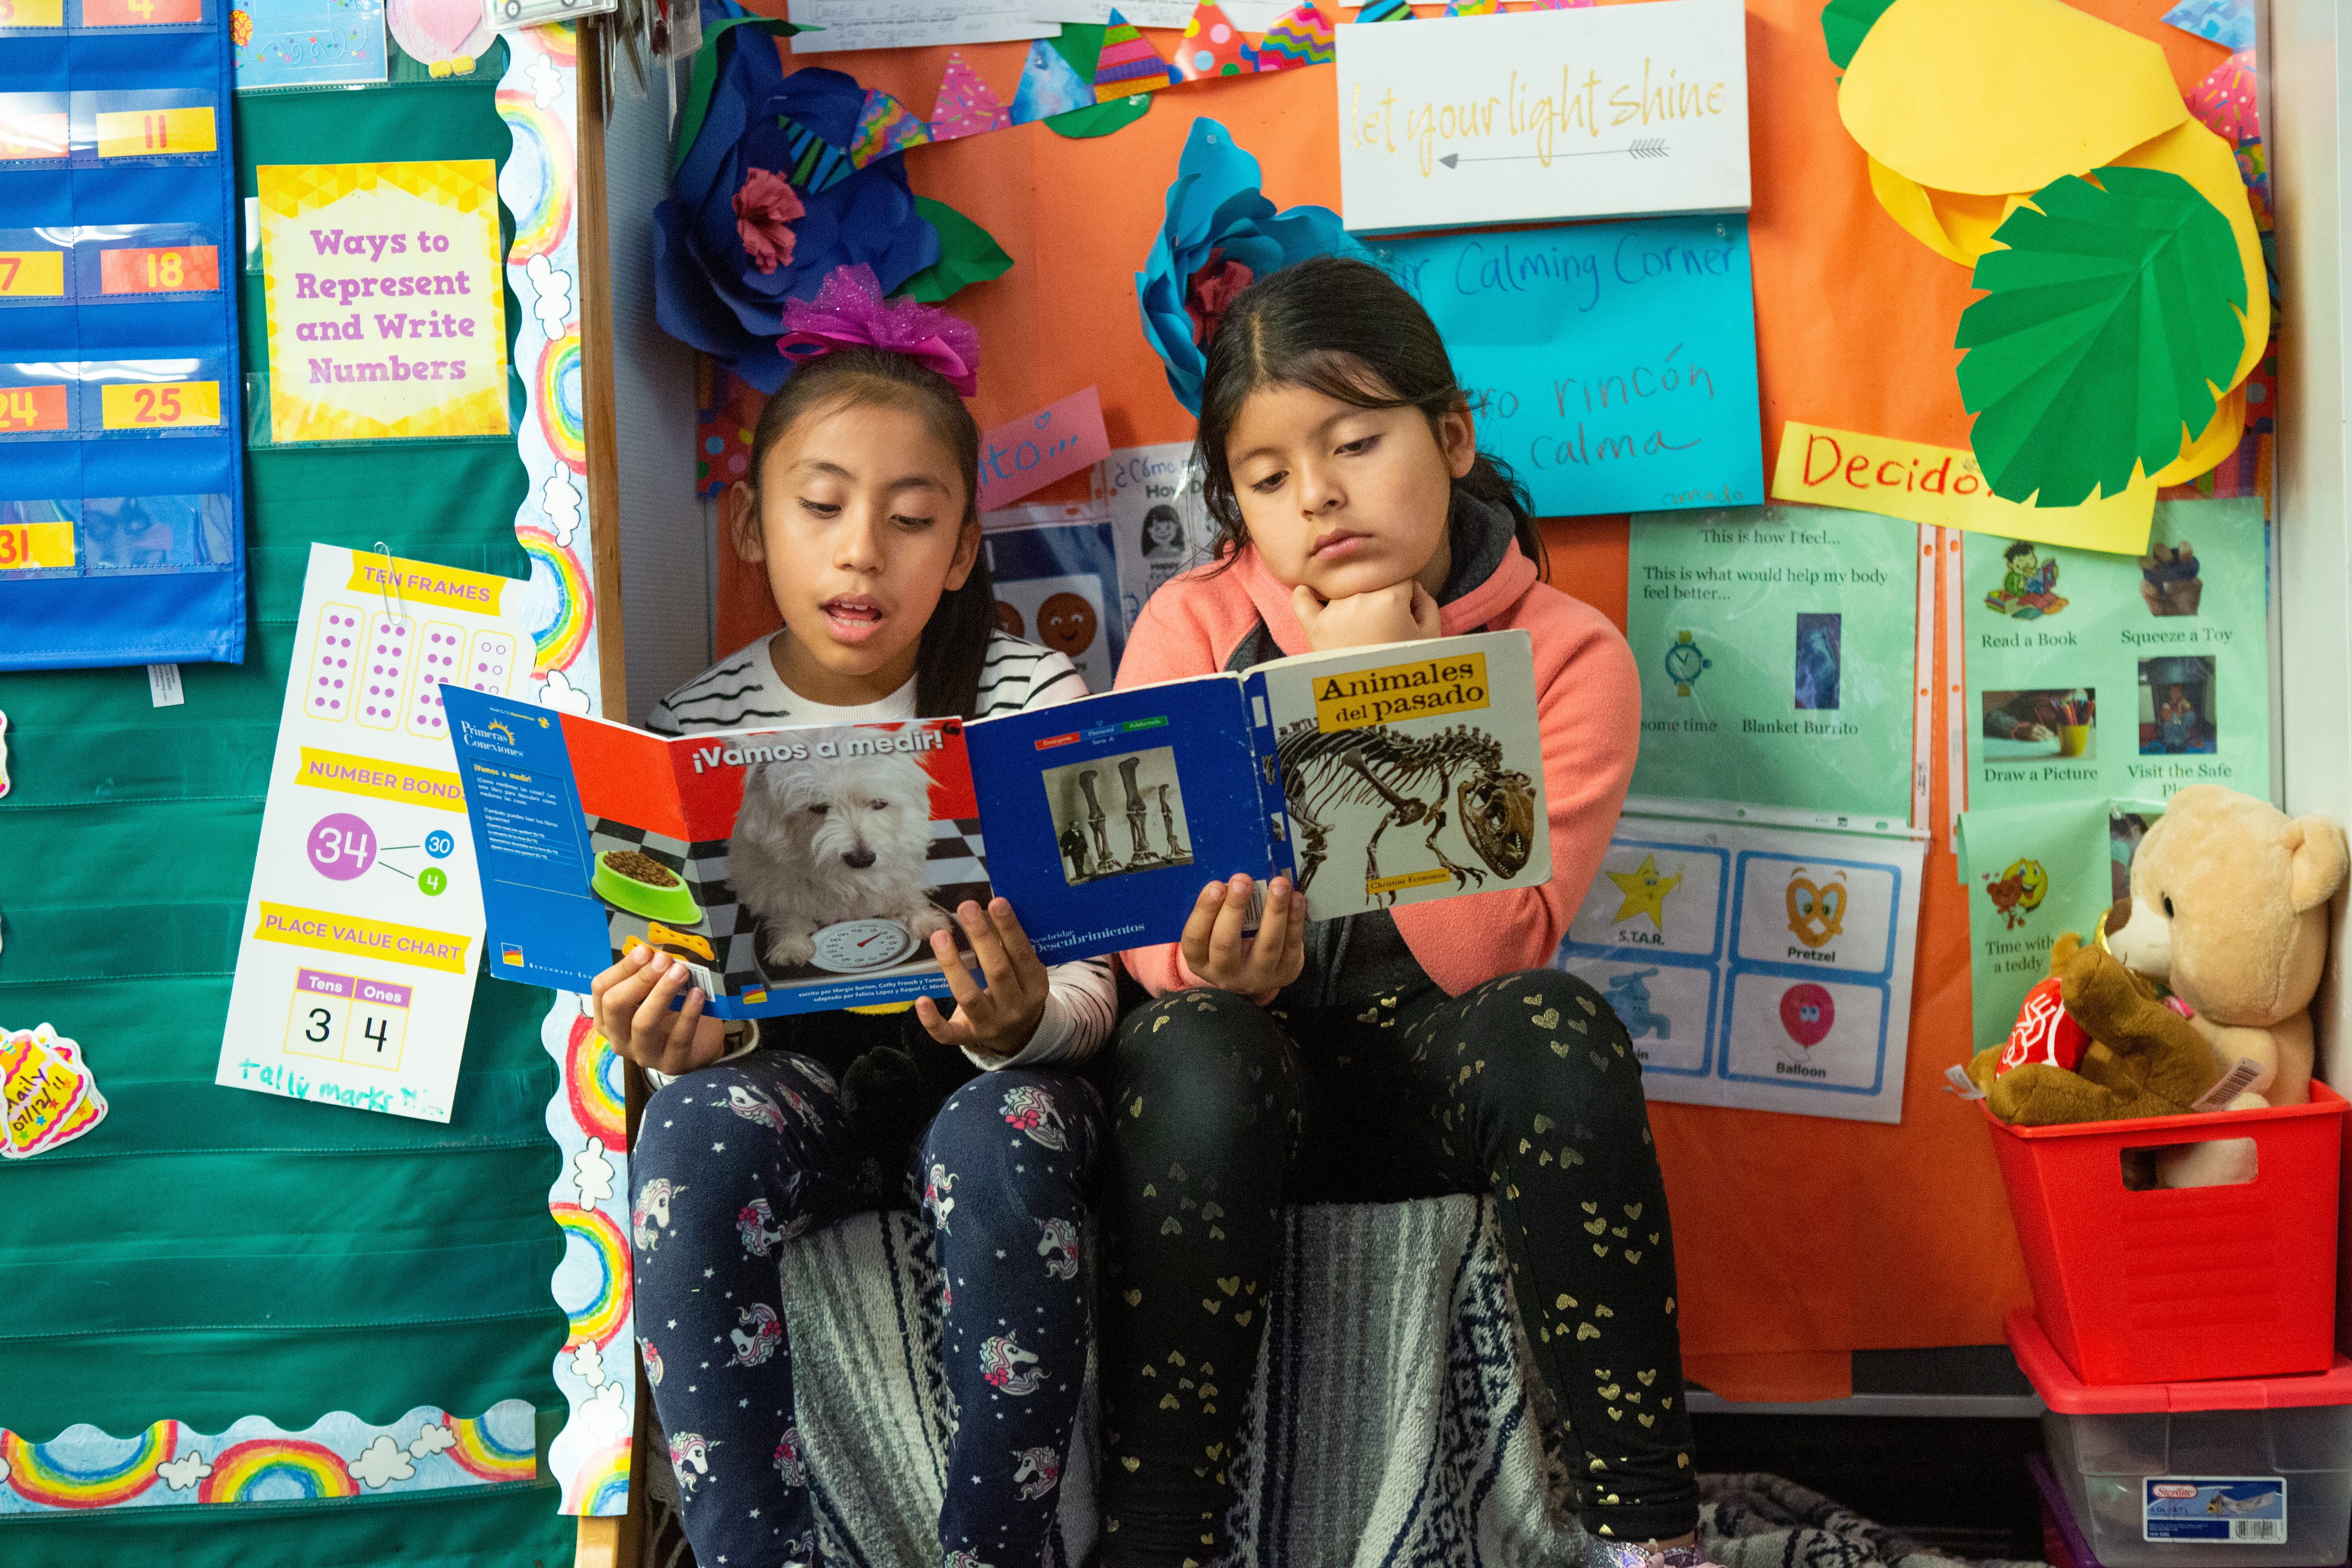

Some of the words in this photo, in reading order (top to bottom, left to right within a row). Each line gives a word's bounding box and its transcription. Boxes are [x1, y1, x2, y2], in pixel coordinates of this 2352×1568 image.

[1352, 83, 1399, 154] let
[1406, 95, 1501, 178] your
[1508, 64, 1603, 167] light
[1609, 57, 1726, 127] shine
[144, 115, 167, 149] 11
[310, 229, 406, 263] Ways
[418, 231, 449, 253] to
[147, 252, 183, 287] 18
[1455, 241, 1600, 312] Calming
[1614, 232, 1735, 284] Corner
[295, 271, 470, 306] Represent
[296, 314, 364, 342] and
[374, 310, 475, 339] Write
[308, 355, 466, 384] Numbers
[1458, 372, 1518, 419] ro
[1554, 342, 1714, 417] rincón
[134, 388, 181, 422] 25
[1531, 422, 1701, 470] calma
[1803, 433, 1994, 498] Decido
[1701, 528, 1734, 544] This
[1738, 529, 1750, 544] is
[1754, 529, 1785, 544] how
[1789, 530, 1797, 544] I
[1801, 530, 1841, 545] feel...
[364, 566, 403, 587] TEN
[407, 574, 491, 603] FRAMES
[1644, 566, 1676, 581] This
[1679, 566, 1692, 581] is
[1696, 567, 1732, 581] what
[1737, 567, 1782, 582] would
[1787, 569, 1820, 587] help
[1824, 573, 1847, 587] my
[1851, 569, 1889, 587] body
[1643, 585, 1671, 600] feel
[1674, 586, 1731, 601] better...
[1981, 632, 2019, 648] Read
[2024, 637, 2033, 646] a
[2038, 631, 2077, 646] Book
[2121, 629, 2185, 646] Squeeze
[2190, 634, 2198, 643] a
[2202, 628, 2233, 645] Toy
[1319, 663, 1473, 701] Animales
[1335, 706, 1368, 723] del
[1372, 684, 1484, 722] pasado
[461, 721, 508, 742] Primeras
[1683, 719, 1717, 732] time
[1742, 718, 1799, 734] Blanket
[1804, 720, 1859, 735] Burrito
[464, 734, 524, 756] Conexiones
[693, 743, 808, 774] ¡Vamos
[817, 740, 838, 758] a
[849, 730, 944, 755] medir!
[309, 761, 397, 789] NUMBER
[1985, 768, 2025, 782] Draw
[2029, 772, 2037, 781] a
[2042, 765, 2098, 781] Picture
[2128, 763, 2161, 779] Visit
[2169, 764, 2193, 777] the
[2198, 763, 2232, 777] Safe
[2163, 783, 2184, 797] Pl
[315, 828, 368, 868] 34
[429, 836, 450, 853] 30
[427, 874, 438, 891] 4
[1371, 880, 1406, 889] Christine
[1408, 873, 1446, 883] Economos
[265, 915, 326, 938] PLACE
[333, 926, 392, 948] VALUE
[397, 937, 461, 961] CHART
[1619, 930, 1664, 946] S.T.A.R.
[1986, 941, 2021, 955] Time
[2025, 936, 2054, 952] with
[1788, 947, 1836, 963] Pretzel
[1994, 964, 2002, 973] a
[2005, 958, 2043, 975] teddy
[309, 976, 342, 993] Tens
[364, 986, 401, 1003] Ones
[305, 1008, 331, 1042] 3
[365, 1017, 387, 1052] 4
[1776, 1063, 1827, 1078] Balloon
[238, 1058, 310, 1099] tally
[320, 1081, 394, 1112] marks
